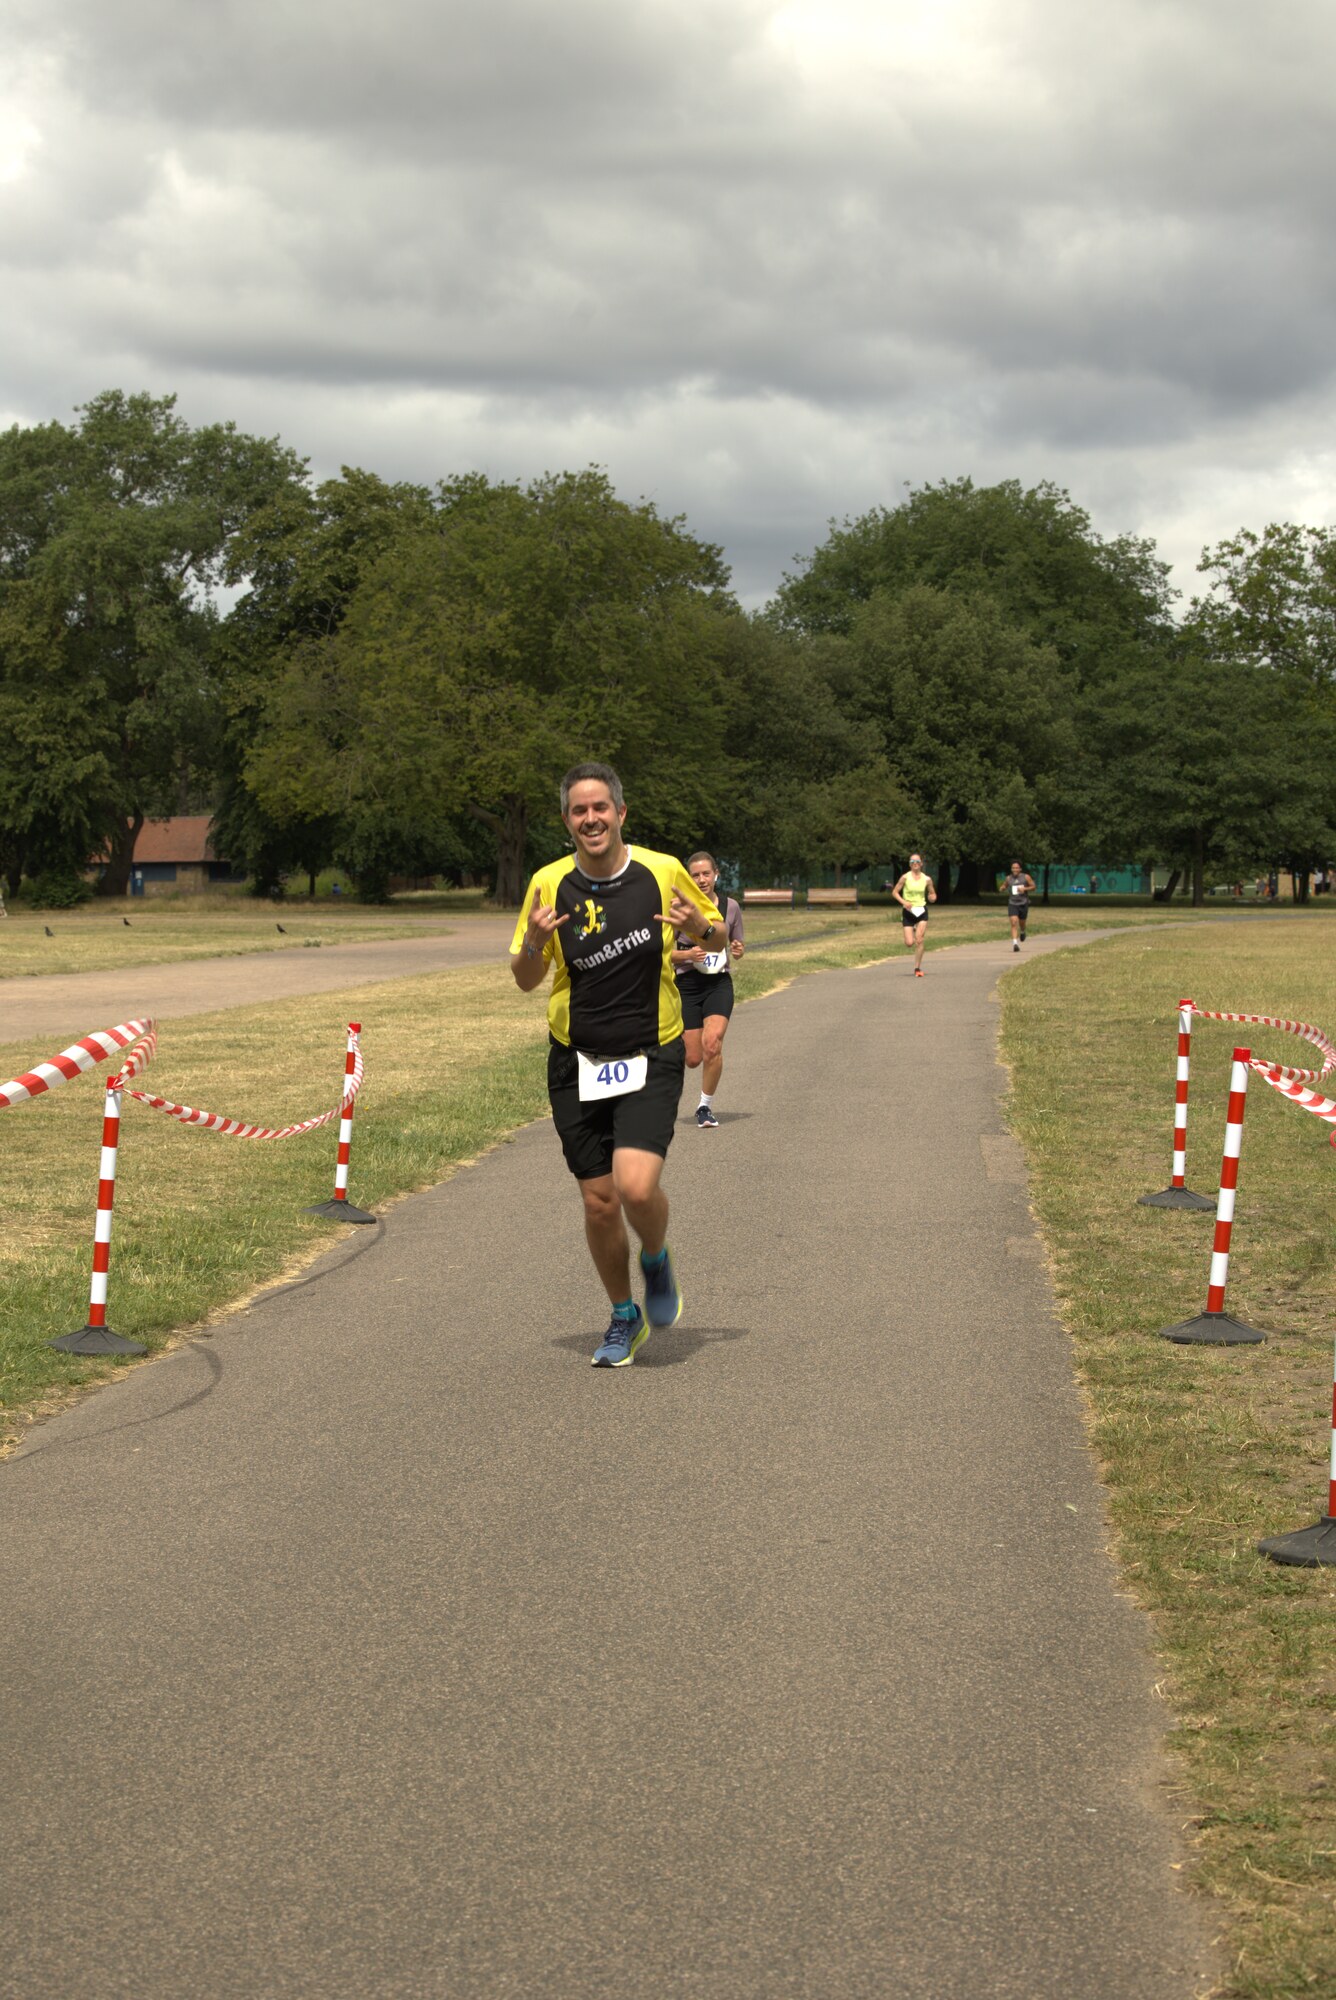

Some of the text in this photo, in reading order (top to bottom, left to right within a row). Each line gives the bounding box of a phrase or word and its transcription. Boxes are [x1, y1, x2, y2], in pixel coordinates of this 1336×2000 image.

[573, 928, 651, 971] Run&Frite
[703, 955, 719, 967] 47
[597, 1060, 629, 1085] 40
